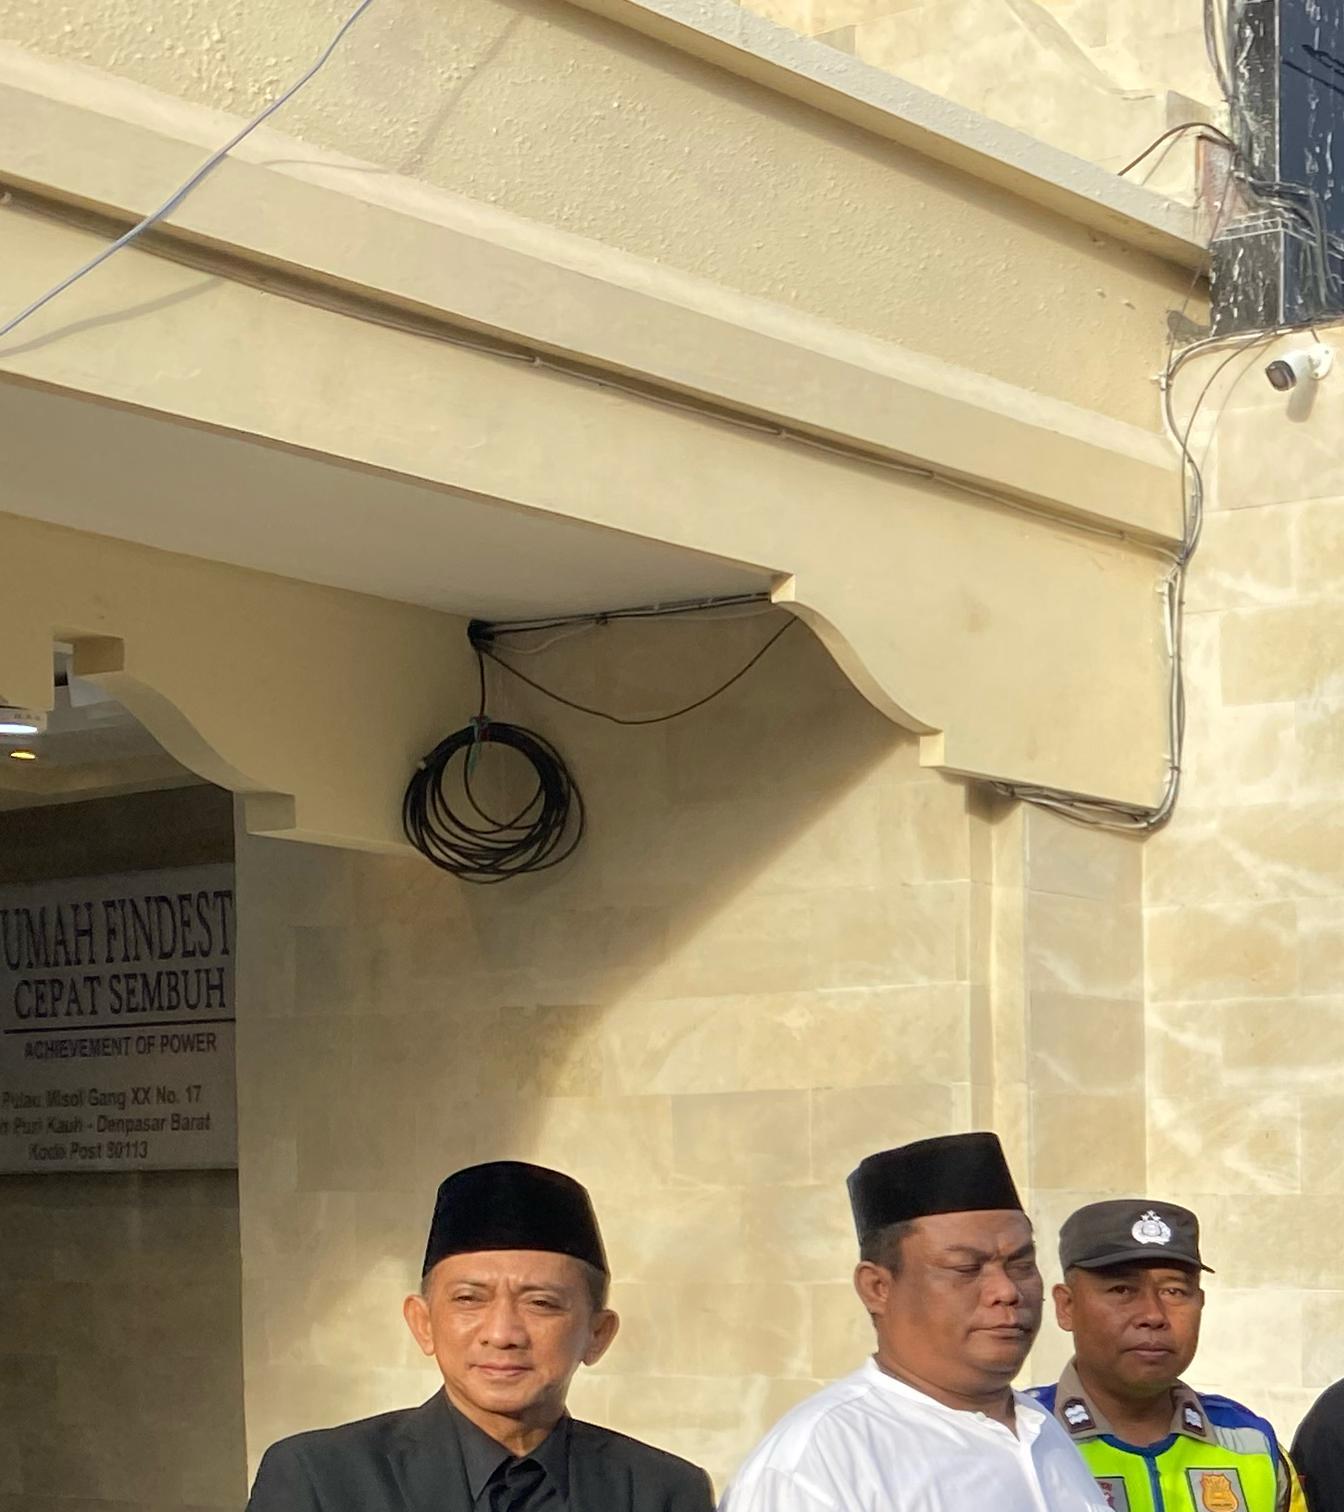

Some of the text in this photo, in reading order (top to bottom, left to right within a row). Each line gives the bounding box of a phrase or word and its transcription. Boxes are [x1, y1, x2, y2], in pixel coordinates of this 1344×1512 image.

[102, 889, 233, 964] FINDEST
[14, 966, 227, 1019] CEPAT SEMBUH
[24, 1032, 218, 1060] ACHIEVEMENT OF POWER
[131, 1087, 151, 1105] XX
[156, 1085, 180, 1105] No.
[185, 1084, 202, 1103] 17
[96, 1113, 167, 1137] Denpasar
[171, 1111, 211, 1131] Barat
